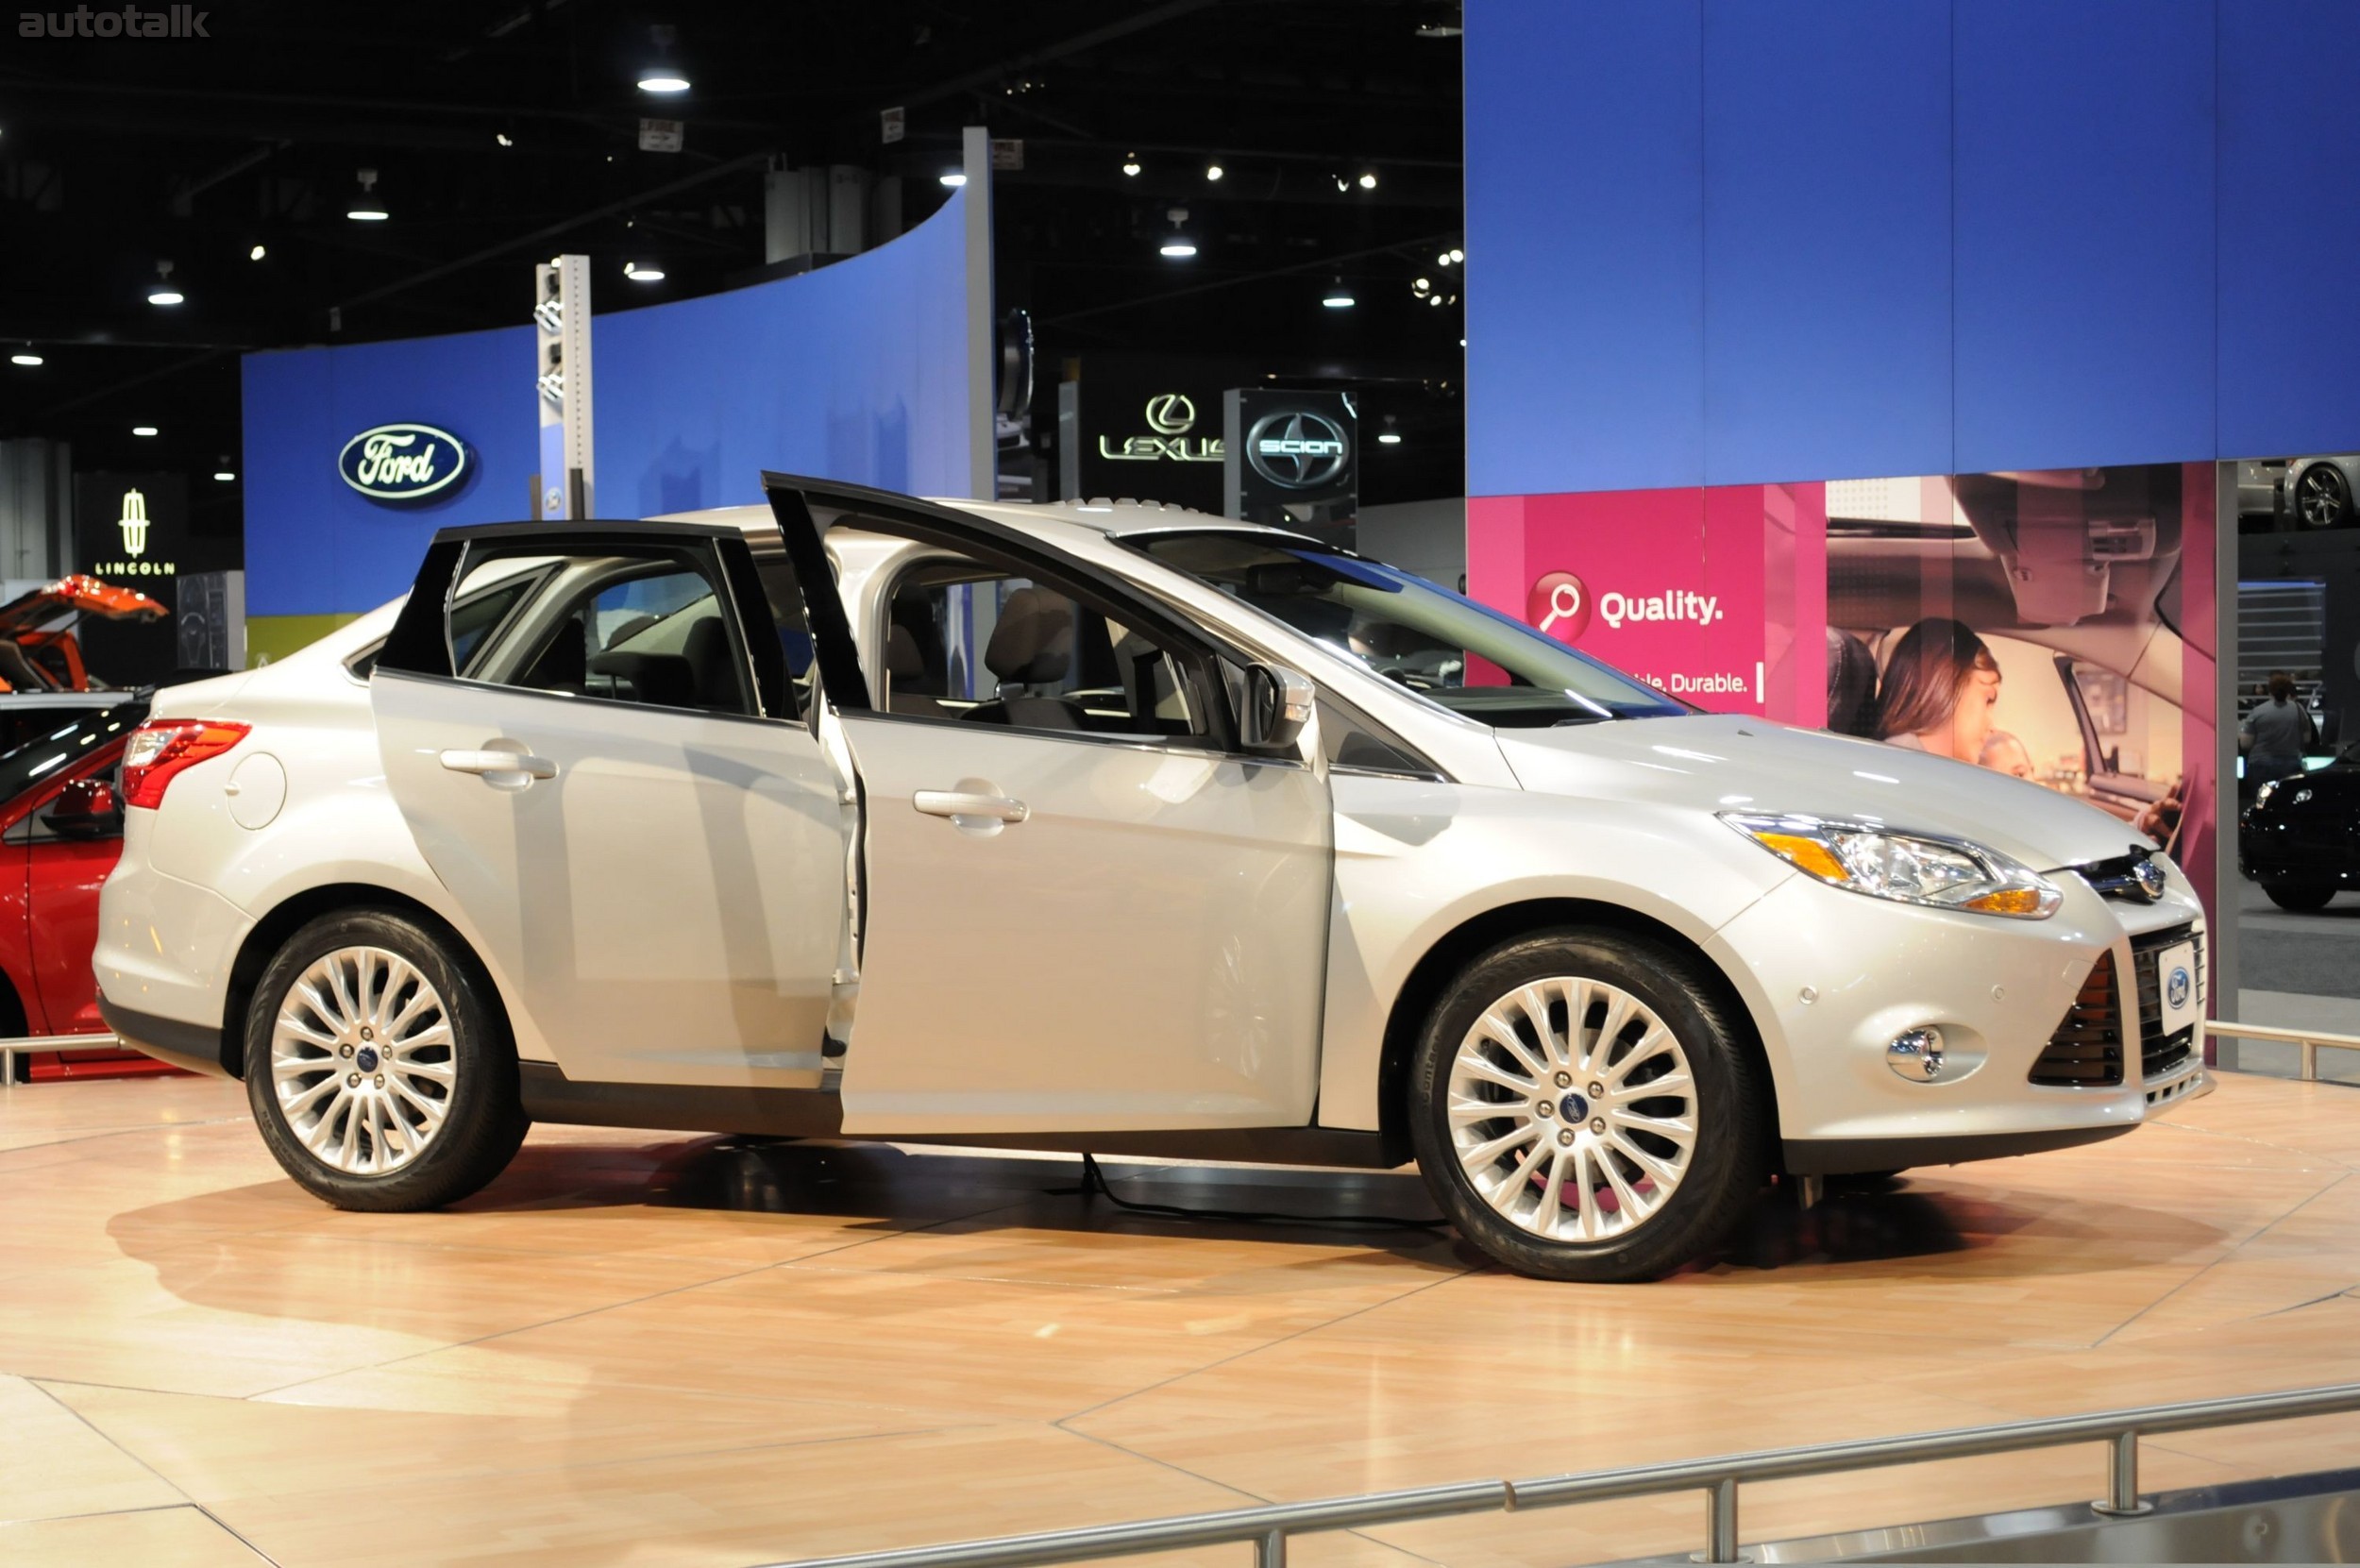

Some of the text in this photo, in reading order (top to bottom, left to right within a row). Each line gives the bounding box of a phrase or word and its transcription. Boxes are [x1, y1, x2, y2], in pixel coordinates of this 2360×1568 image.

[357, 433, 435, 485] Ford
[95, 562, 175, 575] LINCOLN
[1600, 590, 1723, 629] Quality.
[1671, 673, 1747, 692] Durable.
